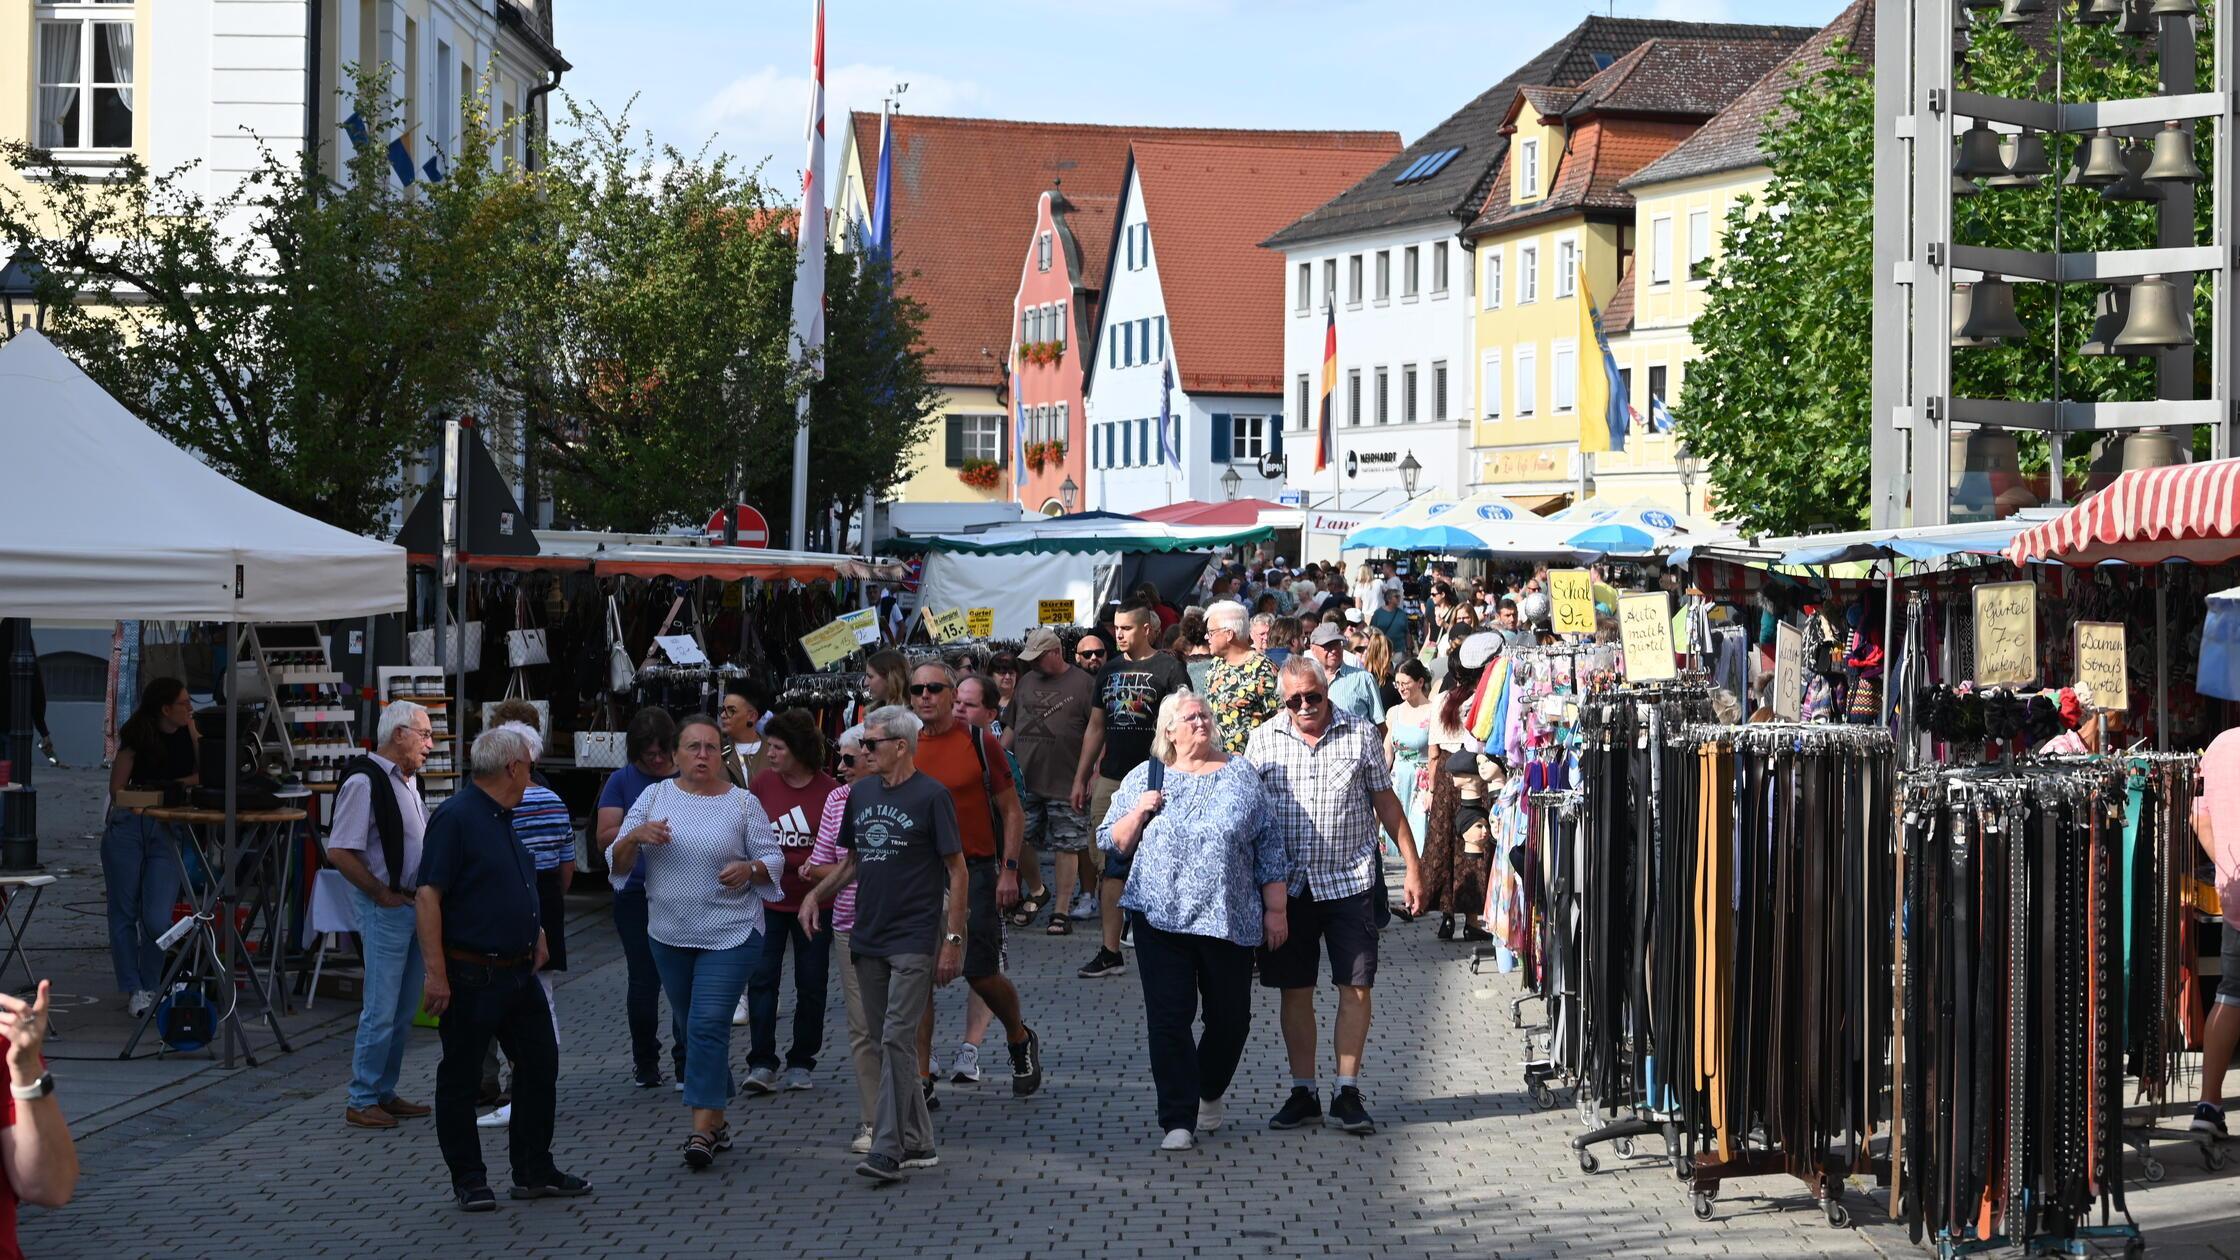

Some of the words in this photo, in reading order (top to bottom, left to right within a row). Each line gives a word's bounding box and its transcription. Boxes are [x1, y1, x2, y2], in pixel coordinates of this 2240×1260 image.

[1360, 452, 1397, 465] NEIDHARDT
[2081, 632, 2122, 651] Damen
[2082, 658, 2121, 677] Straß
[854, 806, 873, 826] TOM
[877, 804, 914, 830] TAILOR
[774, 829, 816, 848] didas
